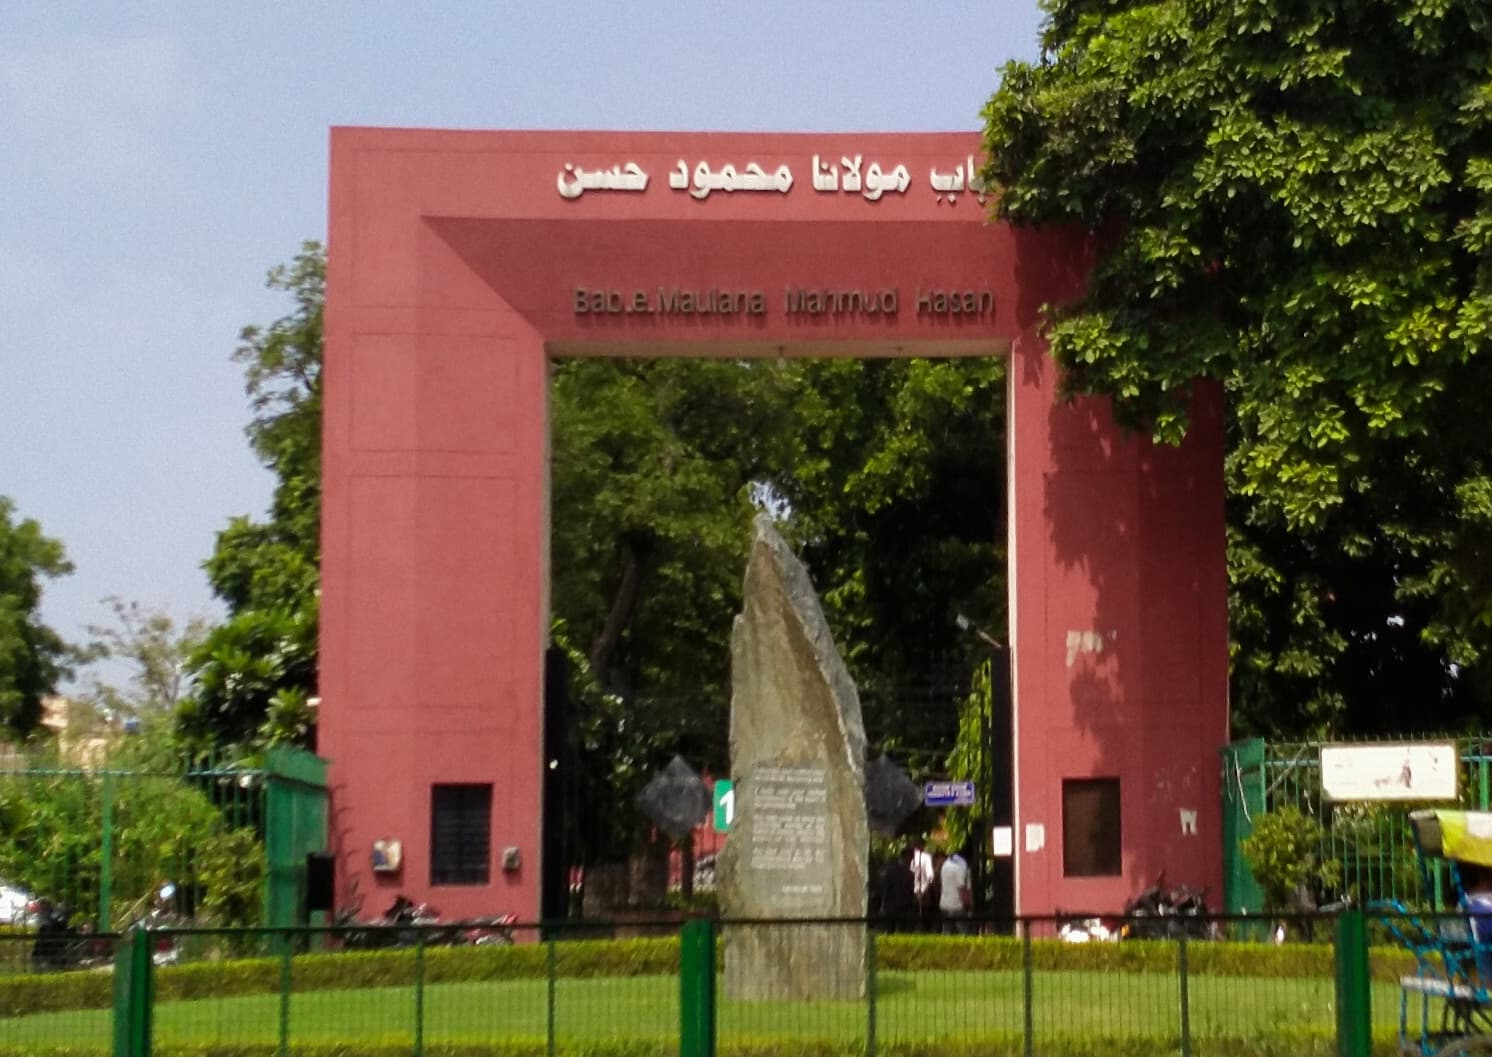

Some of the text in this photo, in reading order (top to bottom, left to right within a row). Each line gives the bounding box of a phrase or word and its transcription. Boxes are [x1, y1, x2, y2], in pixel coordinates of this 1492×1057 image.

[557, 161, 648, 198] حسن
[668, 159, 793, 199] محمود
[812, 153, 911, 201] مولانا
[915, 286, 995, 314] Hasan
